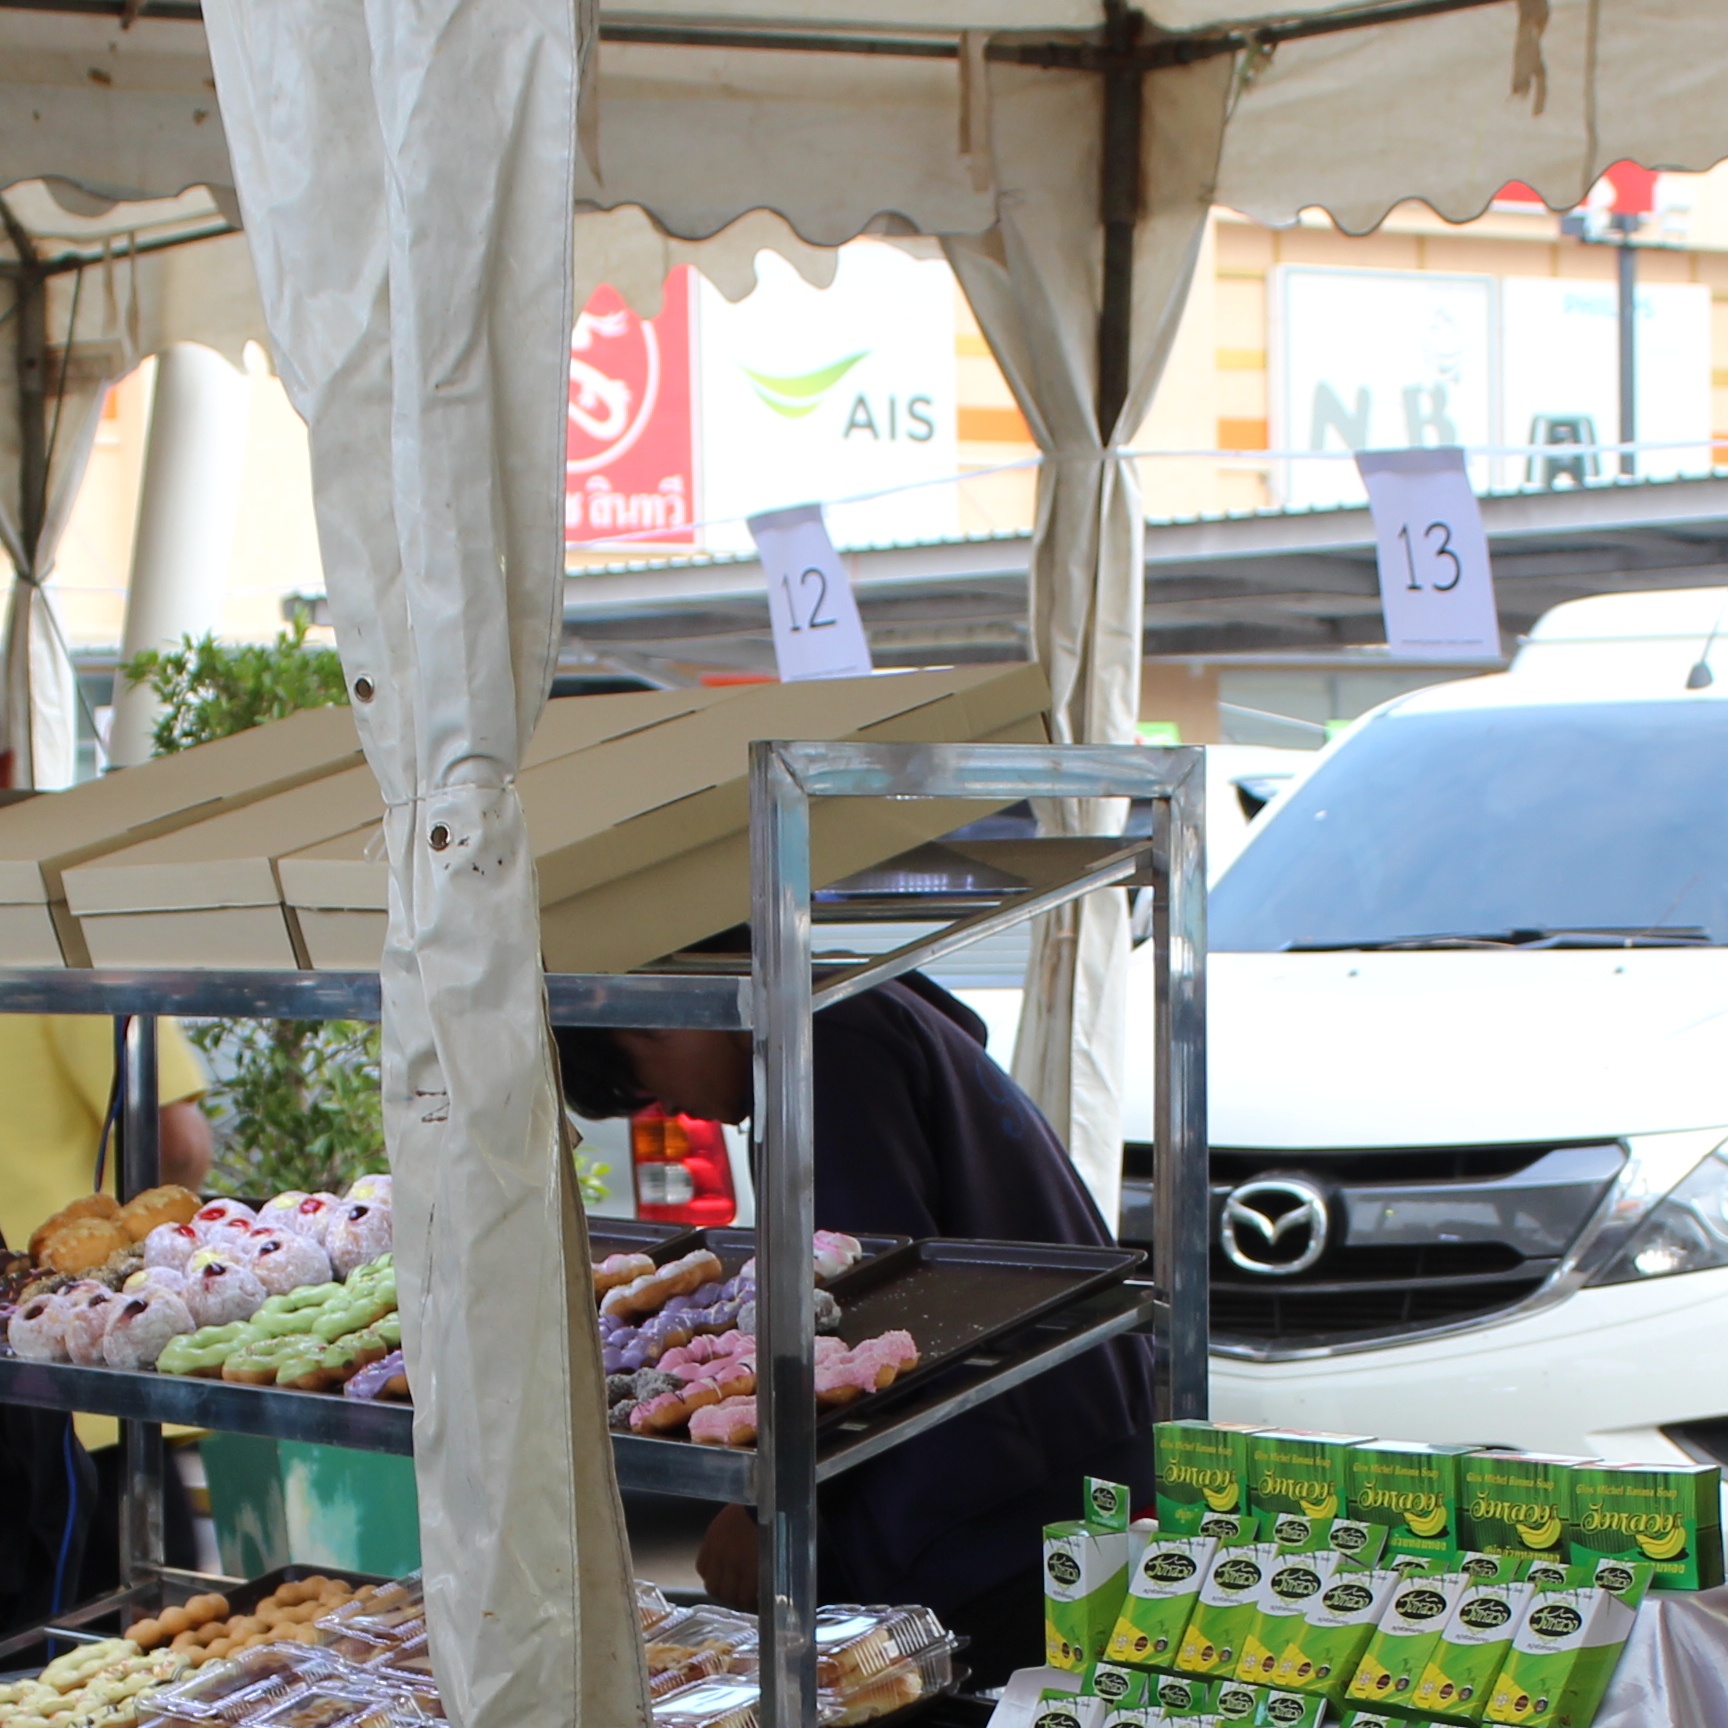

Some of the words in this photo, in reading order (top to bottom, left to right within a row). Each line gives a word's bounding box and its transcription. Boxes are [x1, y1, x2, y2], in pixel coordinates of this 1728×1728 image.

[843, 396, 936, 442] AIS
[1396, 521, 1462, 592] 13
[780, 568, 837, 632] 12
